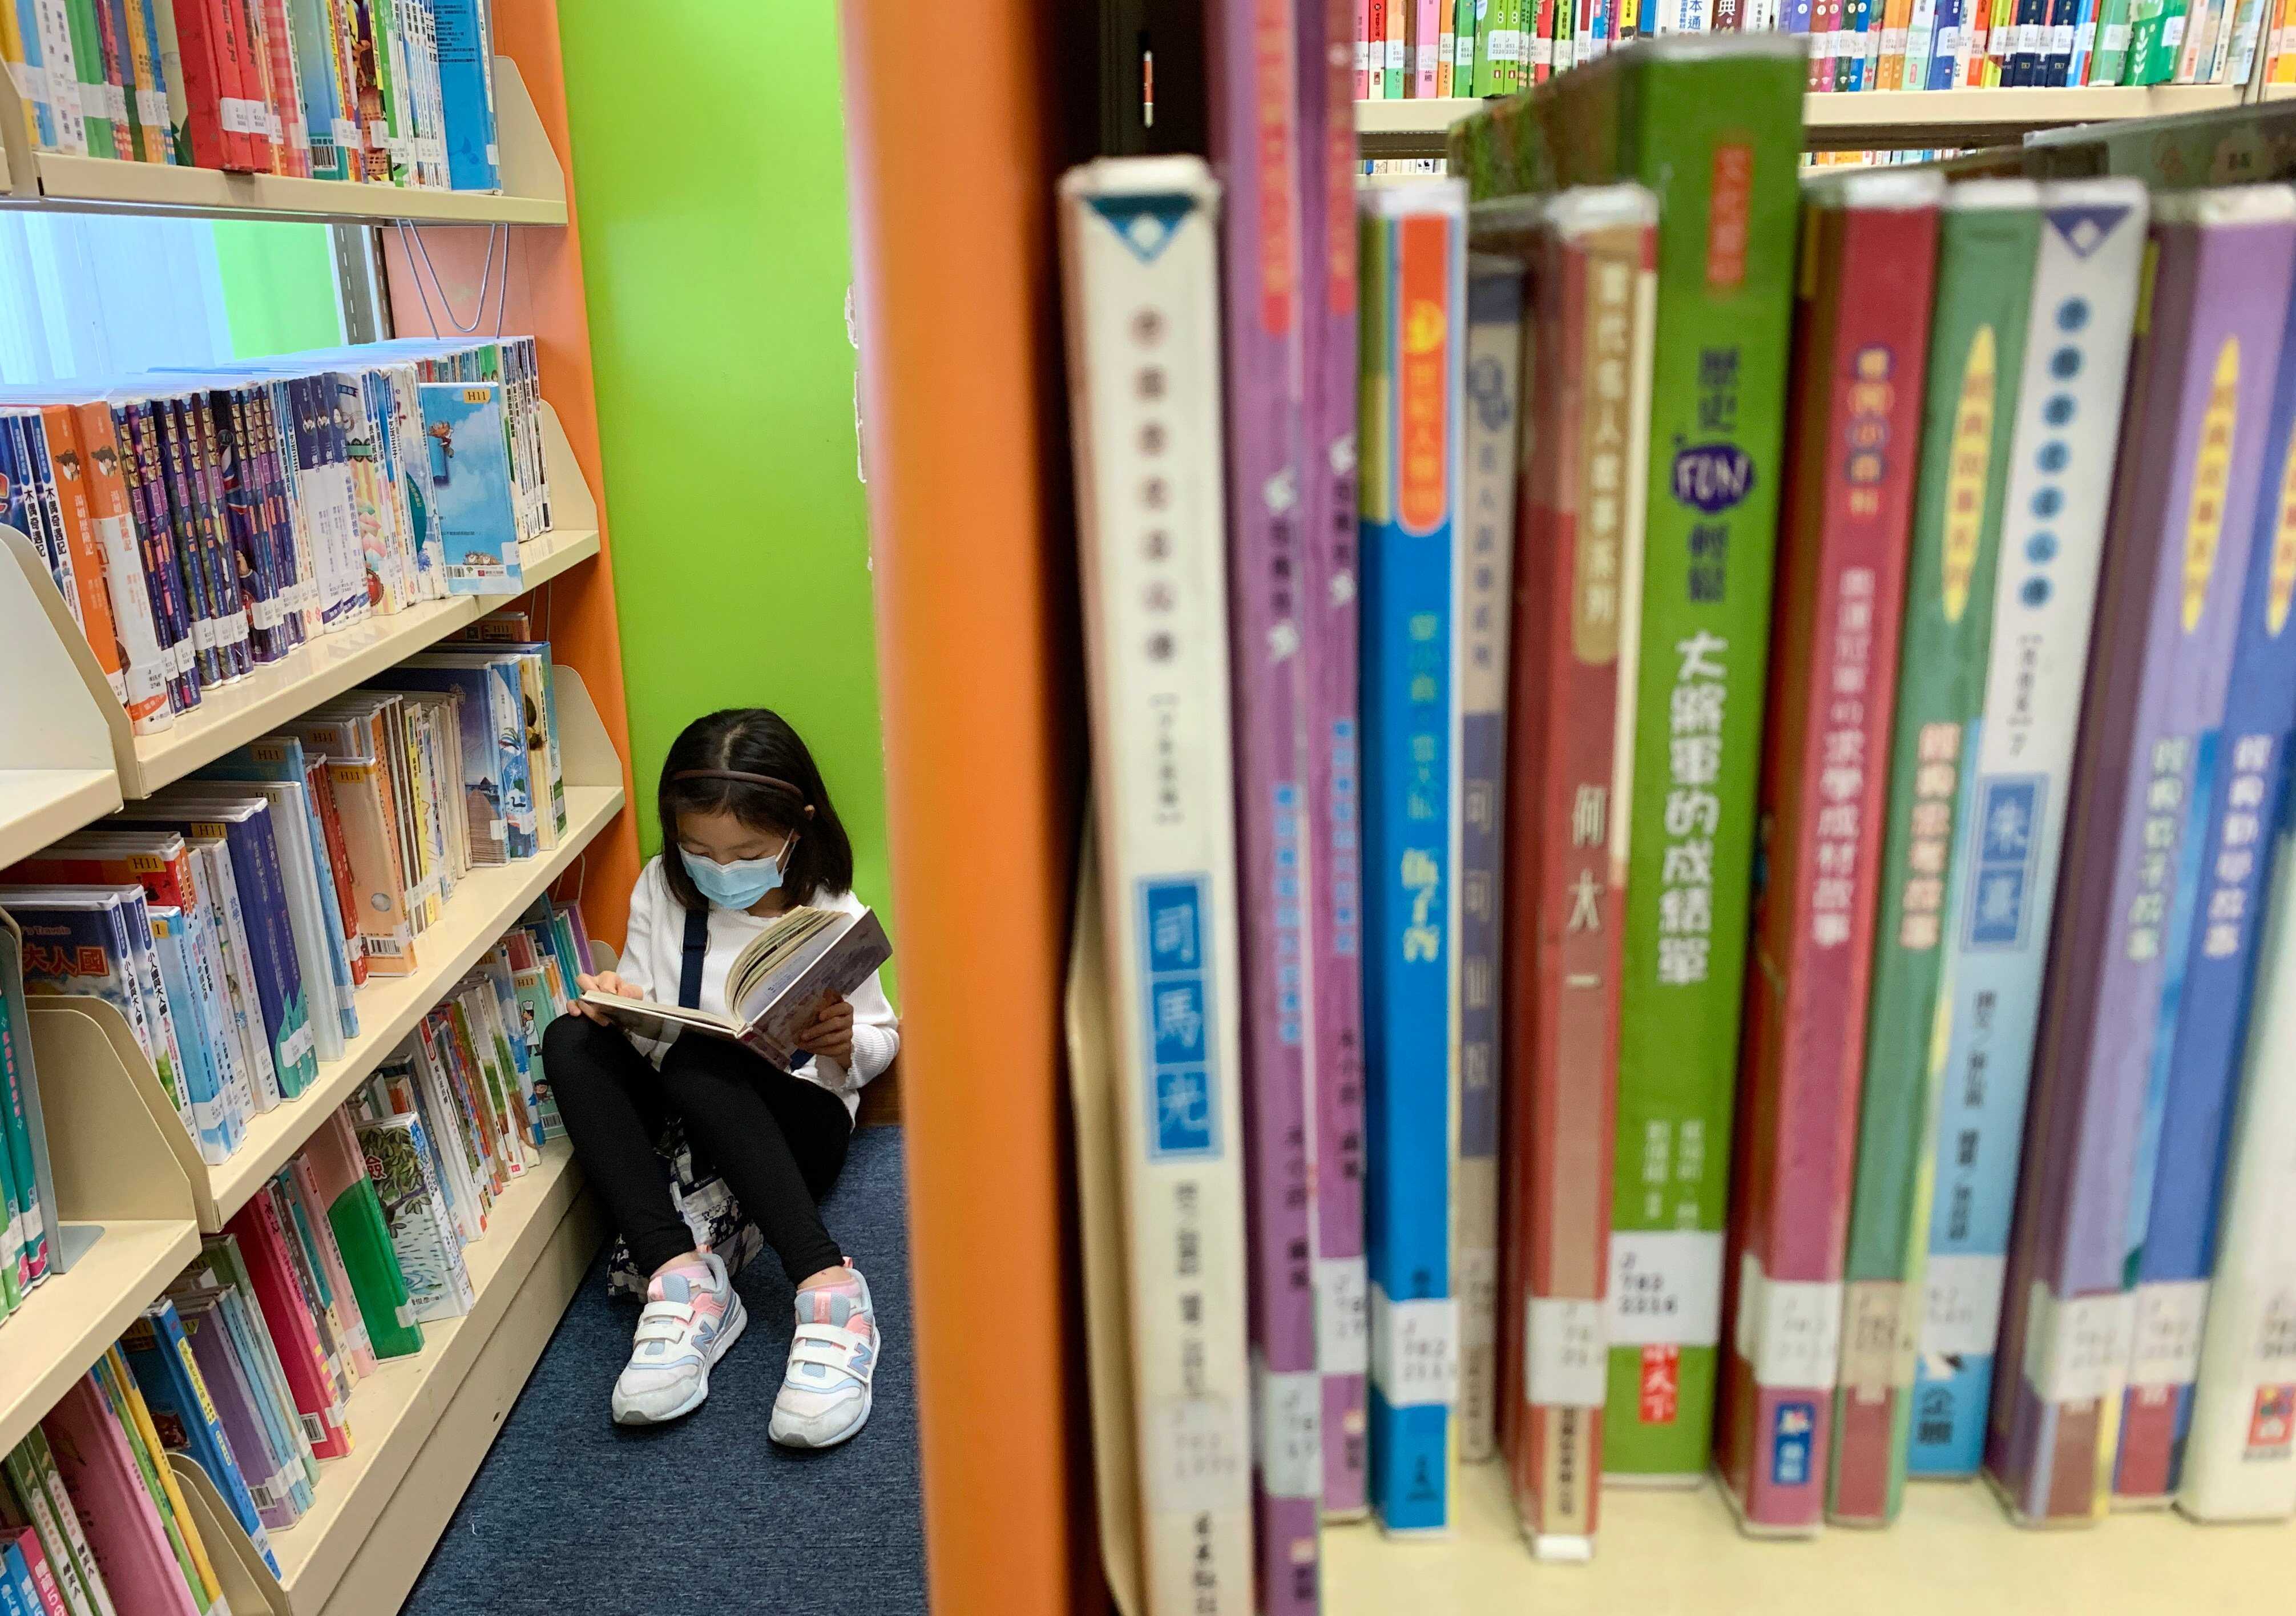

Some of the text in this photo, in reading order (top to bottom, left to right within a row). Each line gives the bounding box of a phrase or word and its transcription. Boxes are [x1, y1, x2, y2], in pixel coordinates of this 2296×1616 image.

[1718, 0, 1736, 17] 典
[467, 391, 486, 401] H11
[24, 489, 46, 558] 木偶奇遇記
[46, 487, 67, 555] 木偶奇遇記
[199, 825, 223, 836] H11
[133, 858, 159, 869] H11
[1565, 782, 1608, 989] 何大一
[23, 943, 110, 977] 大人國
[517, 977, 535, 987] H11
[1152, 899, 1211, 1136] 司馬光
[848, 1342, 873, 1379] N
